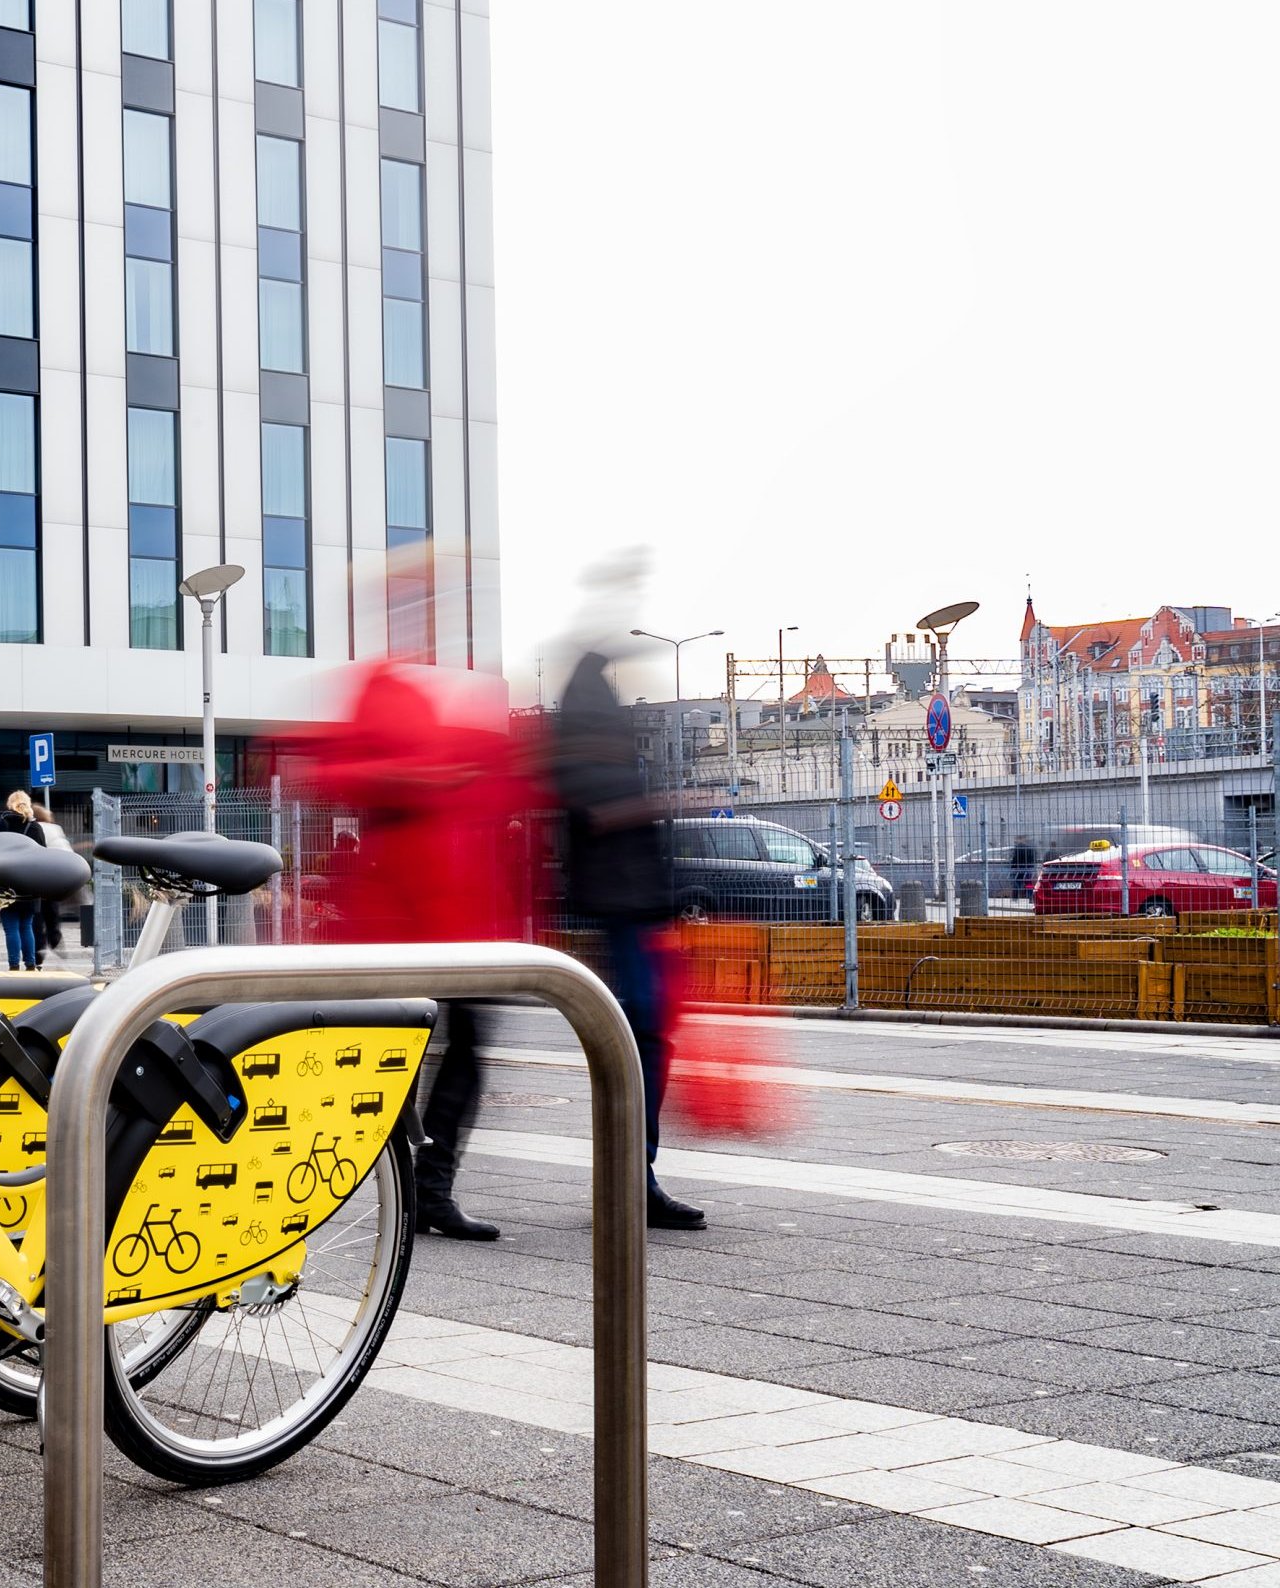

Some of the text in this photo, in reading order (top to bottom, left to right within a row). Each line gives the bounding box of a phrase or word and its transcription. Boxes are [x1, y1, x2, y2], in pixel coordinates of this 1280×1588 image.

[35, 739, 48, 771] P
[112, 749, 204, 760] MERCURE HOTEL
